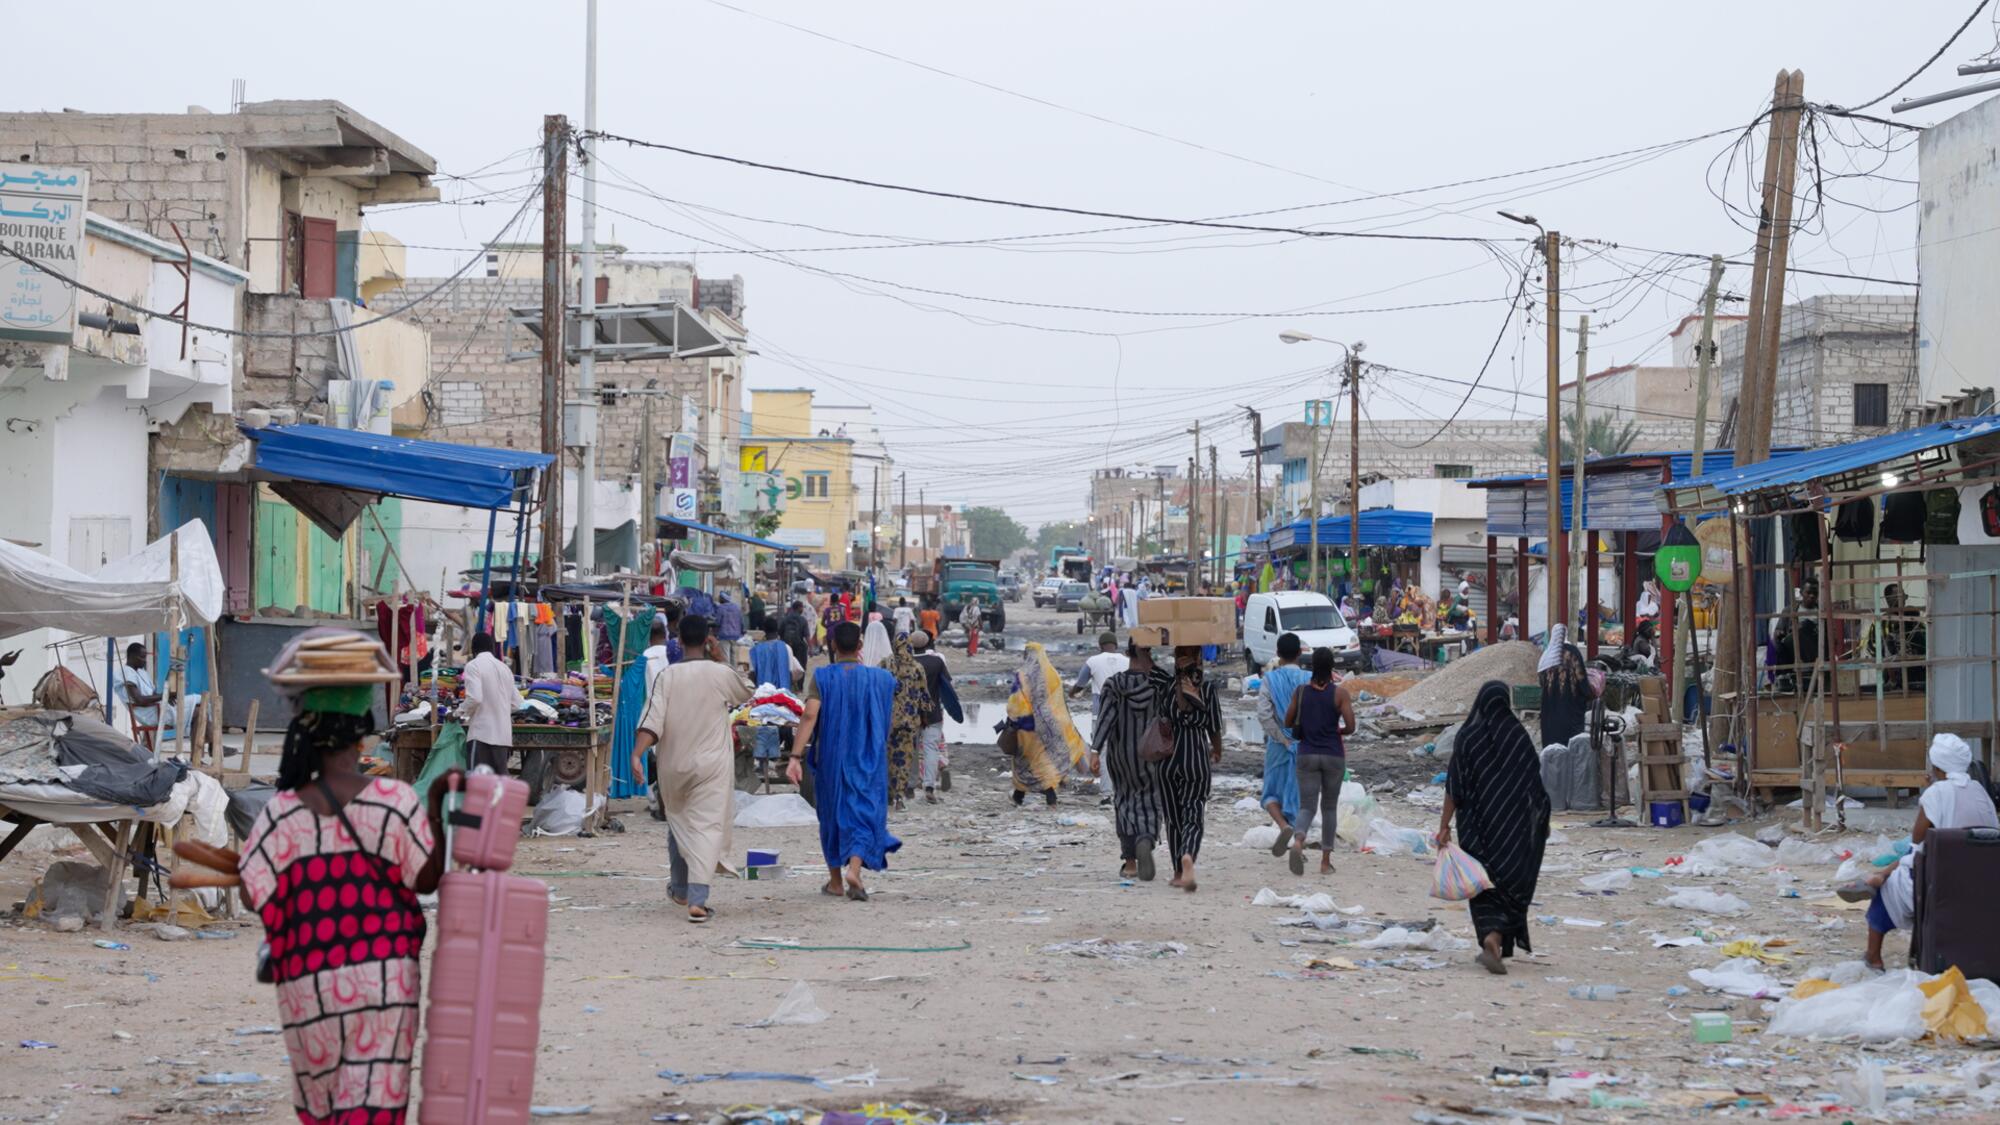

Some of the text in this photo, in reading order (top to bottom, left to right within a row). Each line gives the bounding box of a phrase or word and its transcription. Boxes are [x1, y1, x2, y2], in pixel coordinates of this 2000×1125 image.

[0, 199, 71, 225] البرك
[0, 222, 66, 241] BOUTIQUE
[14, 240, 75, 260] BARAKA
